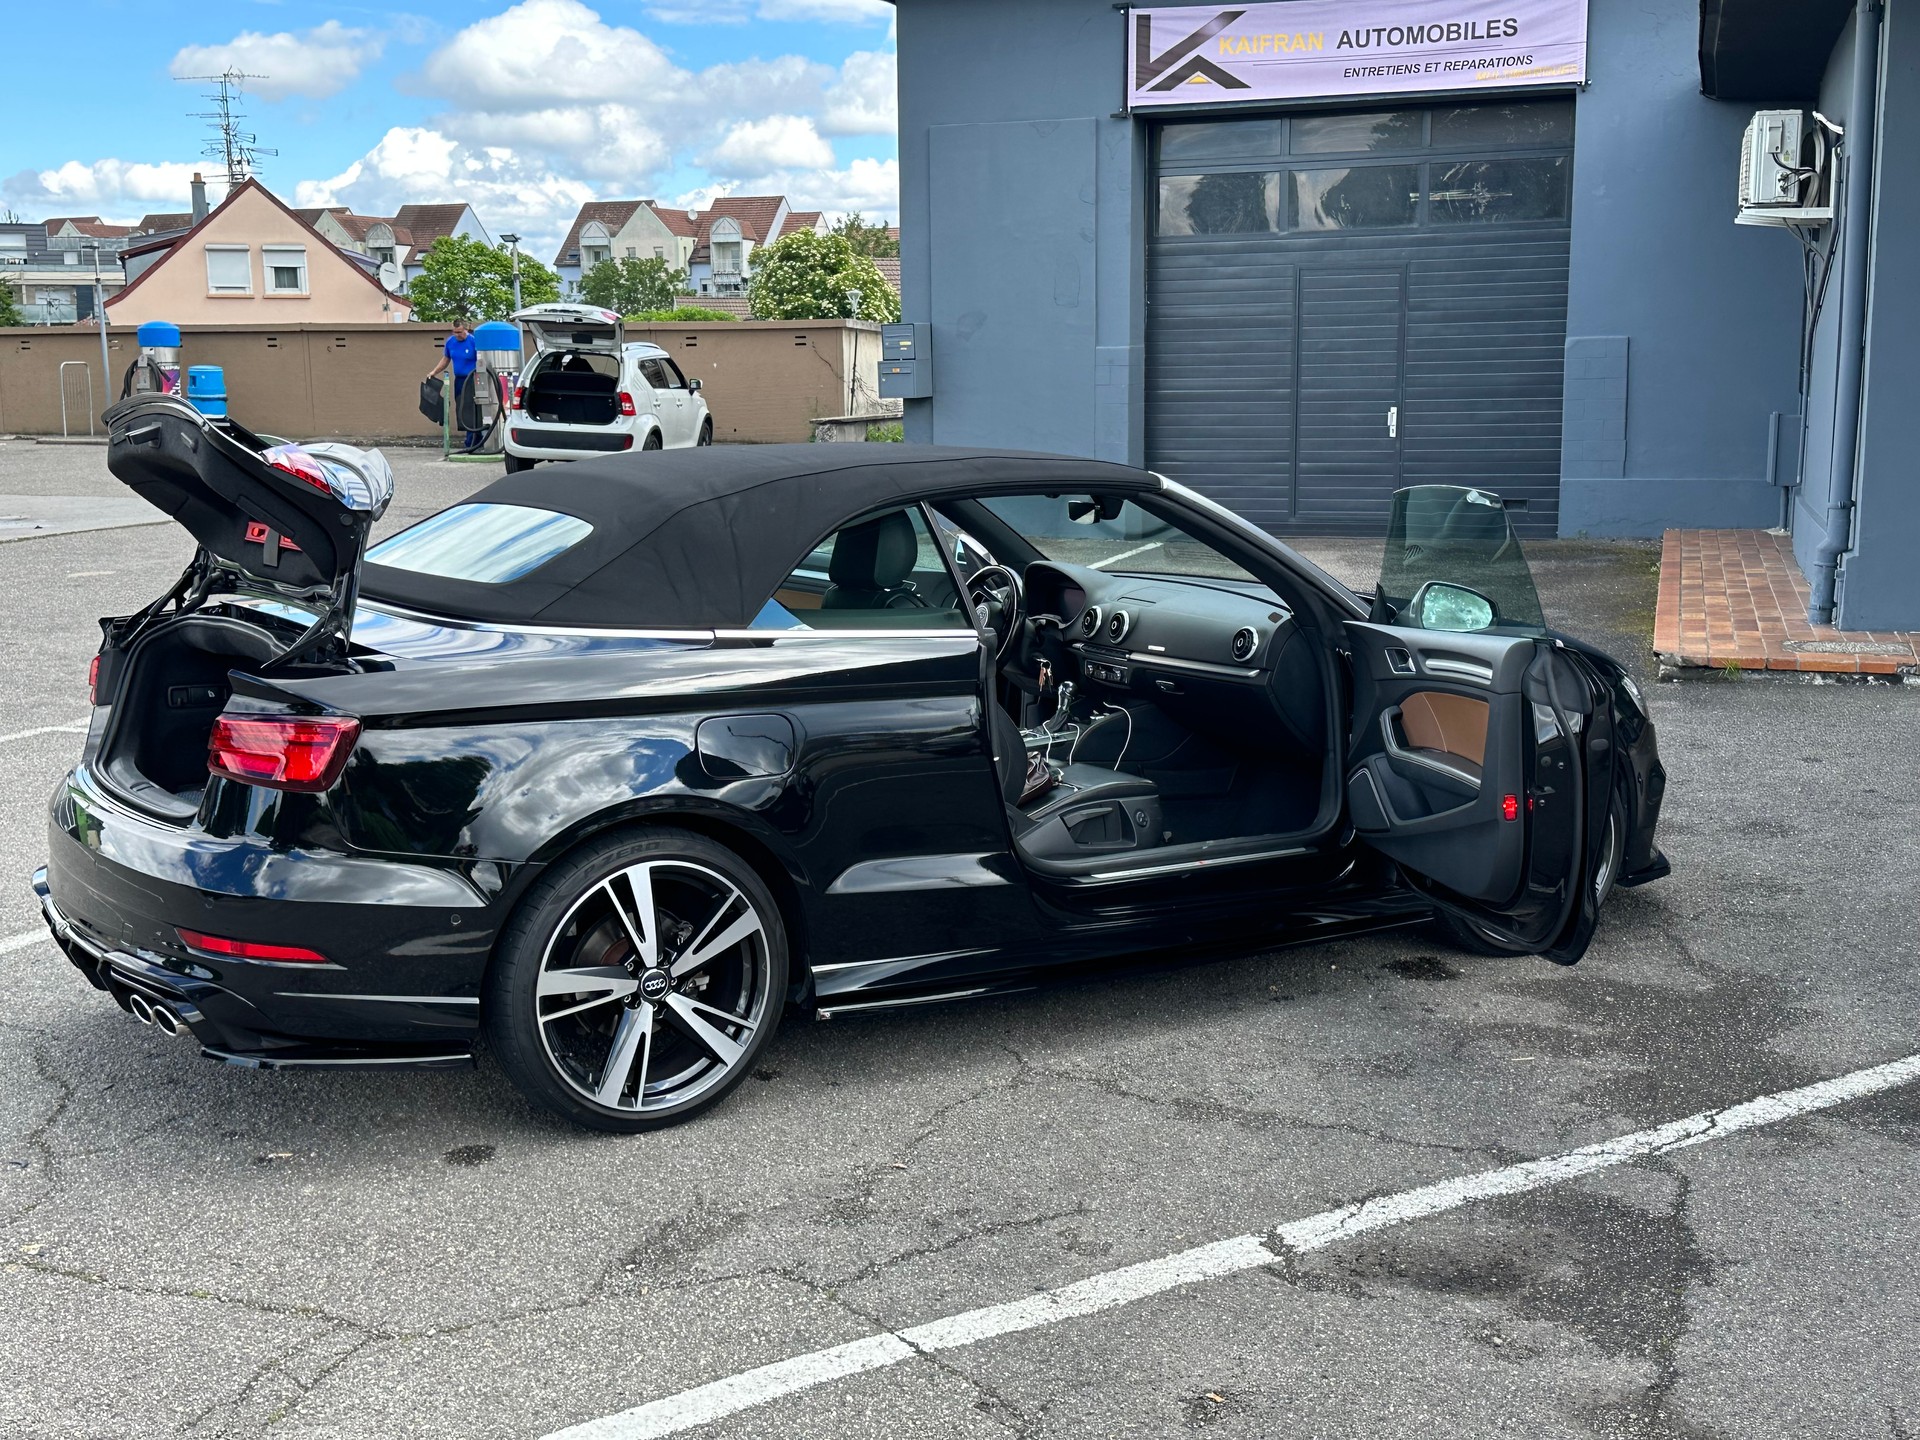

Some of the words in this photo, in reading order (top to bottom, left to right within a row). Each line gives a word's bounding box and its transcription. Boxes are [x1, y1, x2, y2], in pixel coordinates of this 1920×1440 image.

[1219, 31, 1324, 56] KAIFRAN
[1336, 17, 1518, 49] AUTOMOBILES
[1343, 63, 1421, 78] ENTRETIENS
[1424, 62, 1441, 73] ET
[1443, 54, 1534, 72] REPARATIONS
